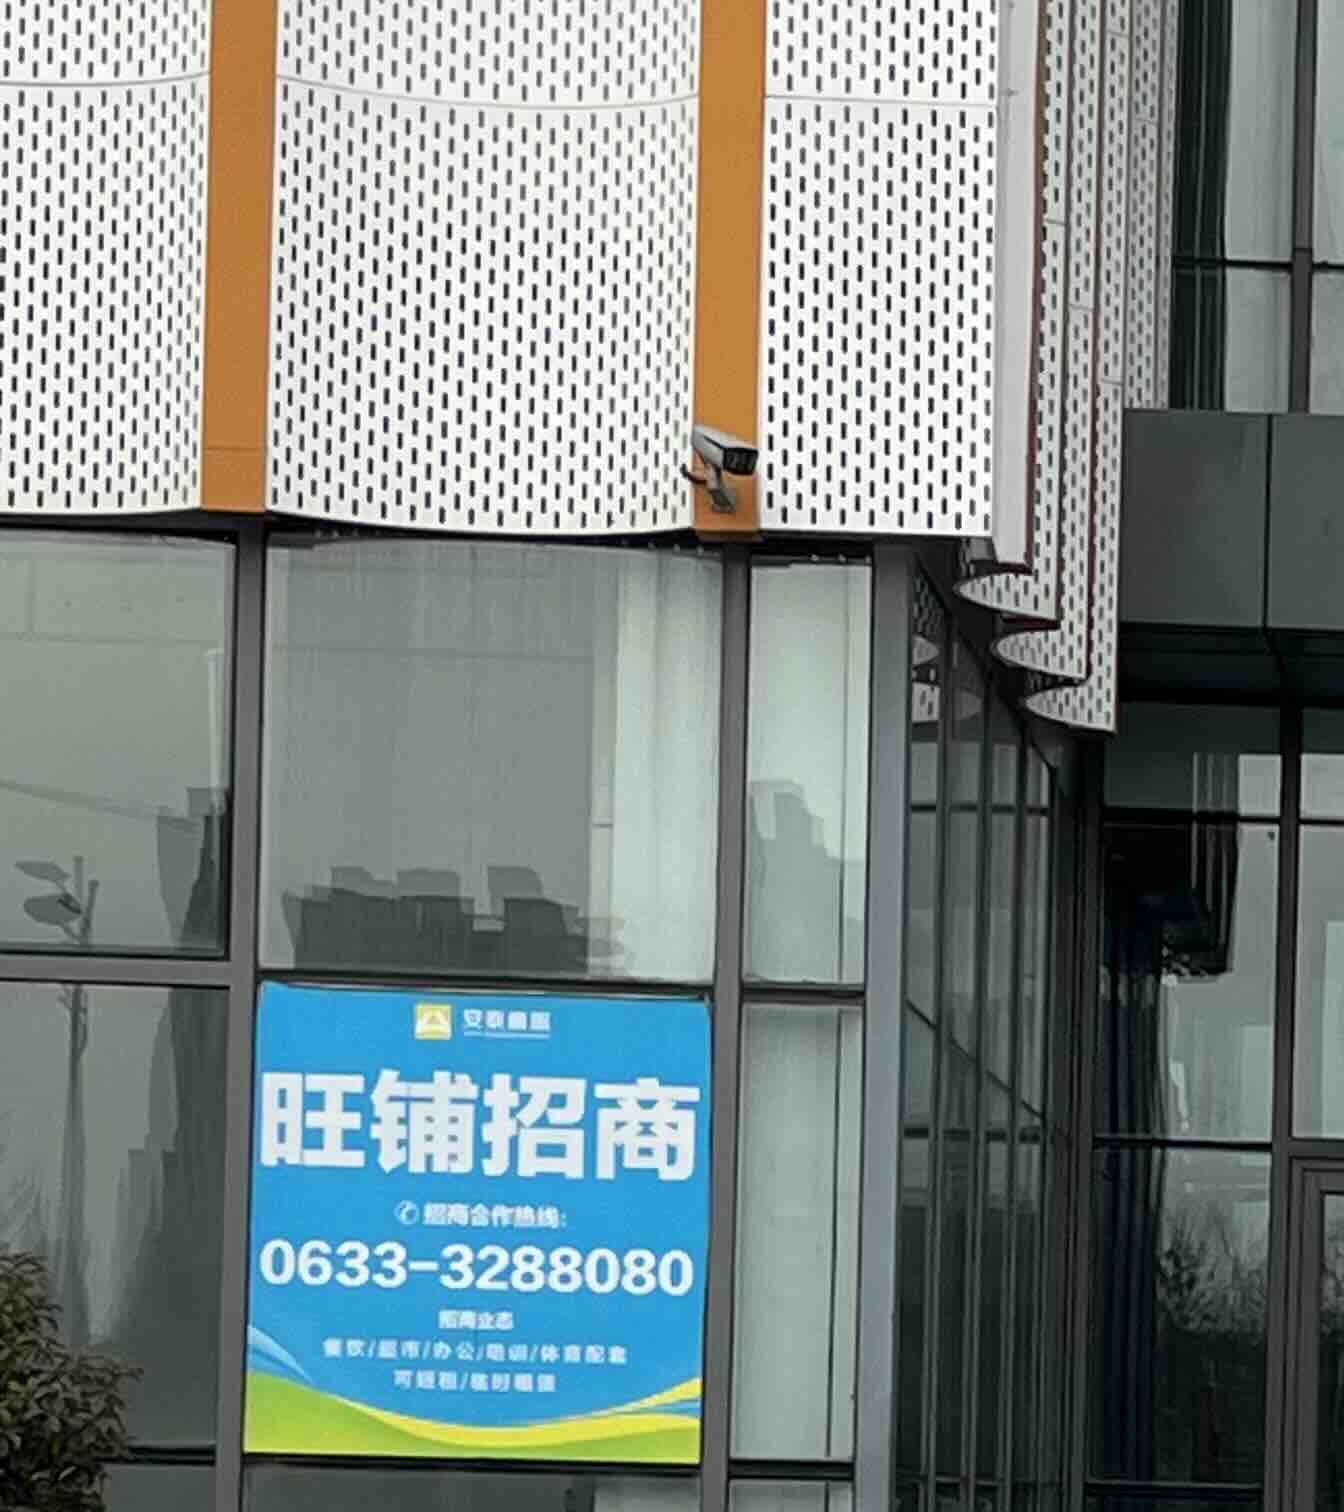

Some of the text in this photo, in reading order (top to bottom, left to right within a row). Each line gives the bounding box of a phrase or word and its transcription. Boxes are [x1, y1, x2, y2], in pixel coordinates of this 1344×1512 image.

[260, 1068, 701, 1181] 旺铺招商
[260, 1238, 694, 1297] 0633-3288080
